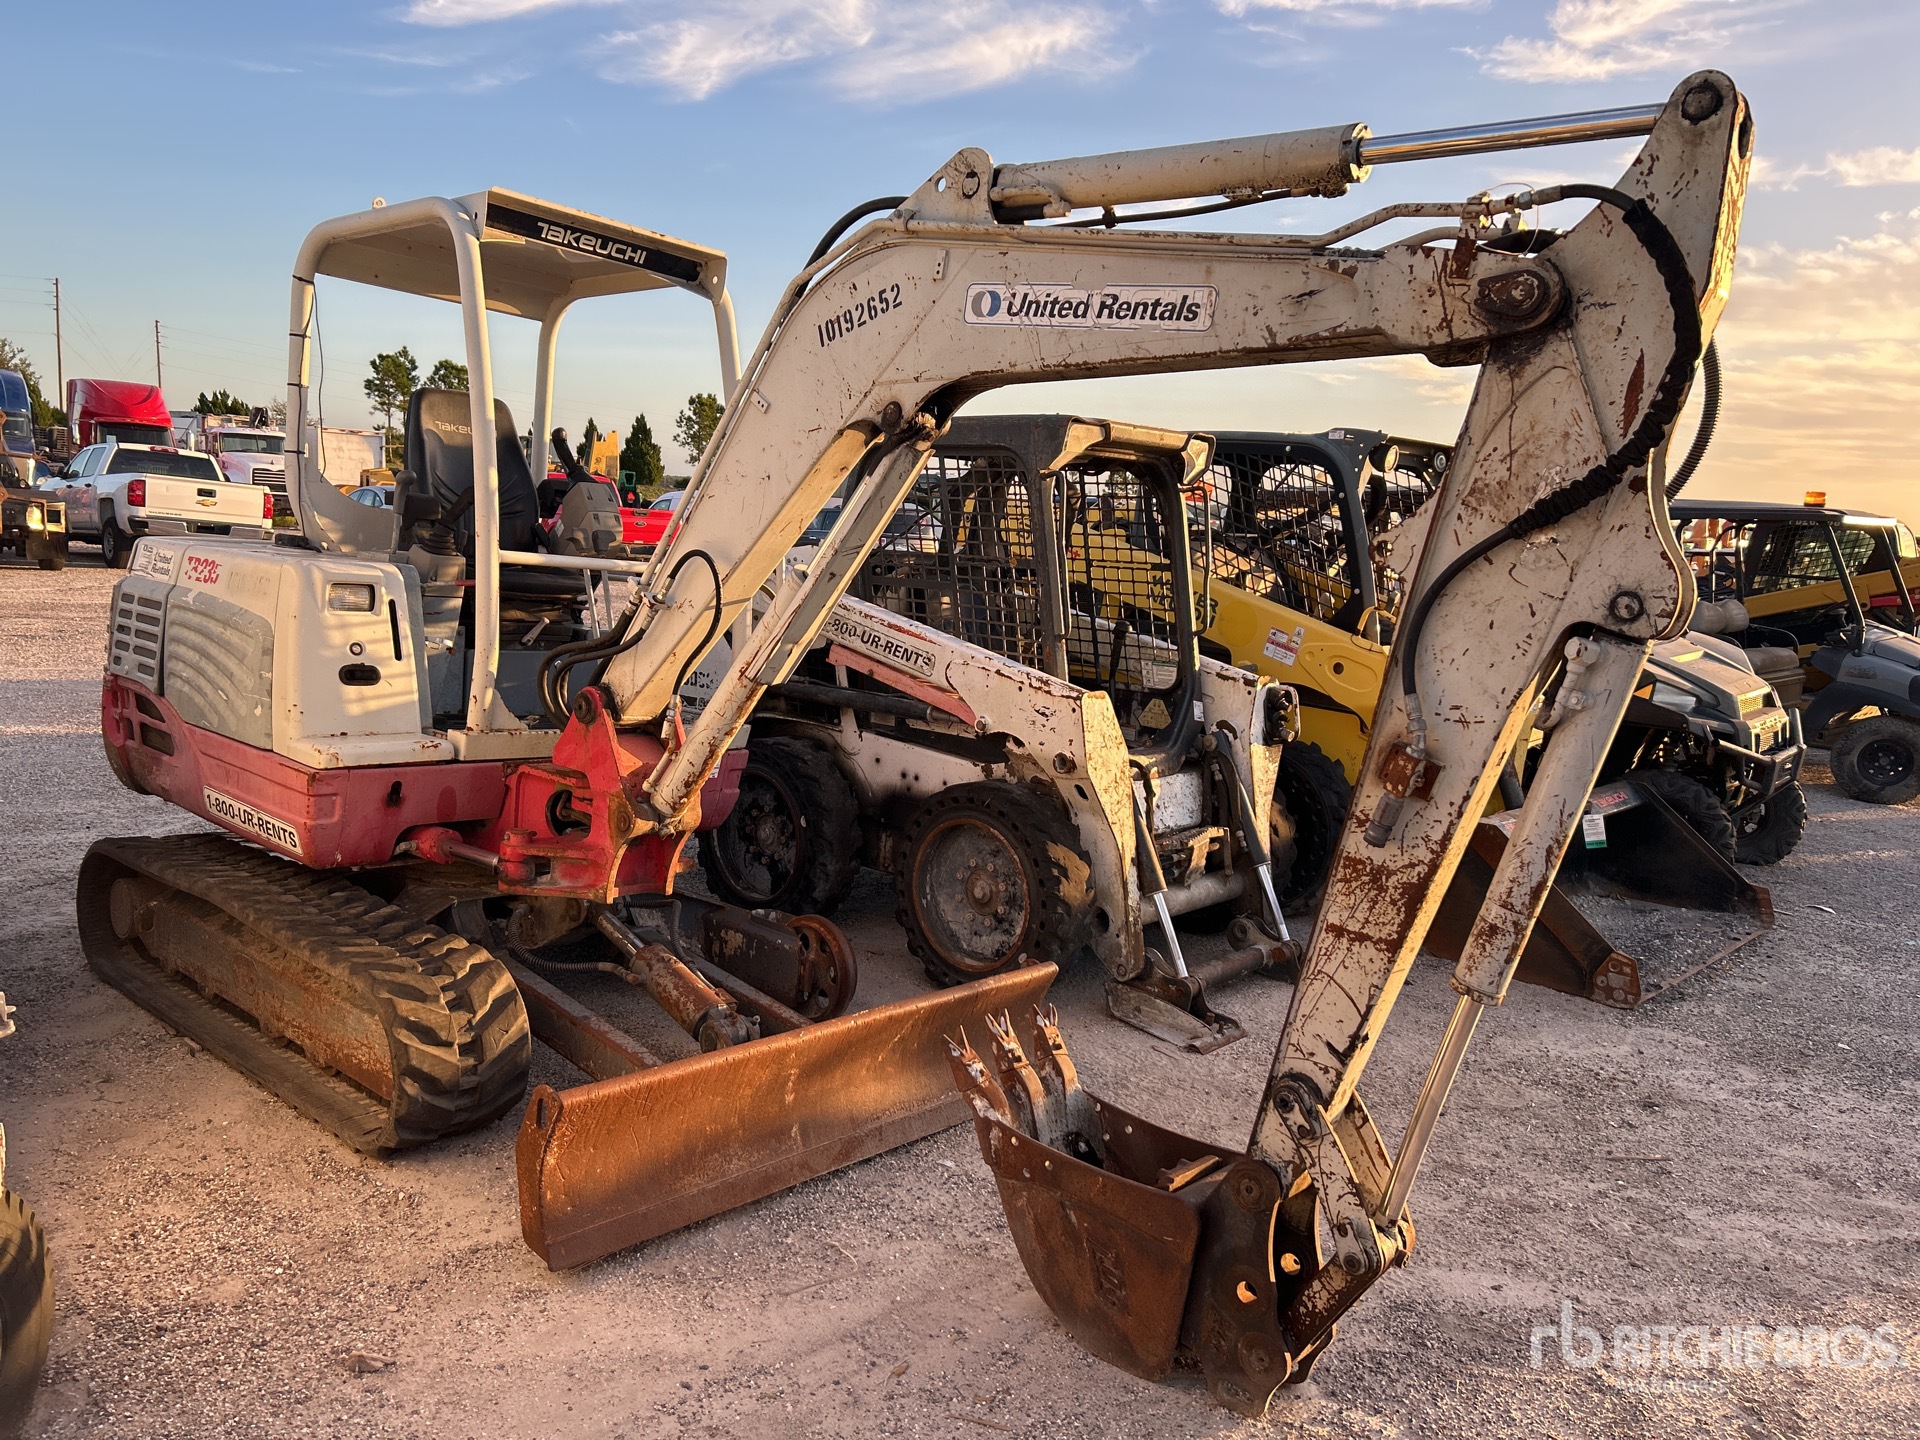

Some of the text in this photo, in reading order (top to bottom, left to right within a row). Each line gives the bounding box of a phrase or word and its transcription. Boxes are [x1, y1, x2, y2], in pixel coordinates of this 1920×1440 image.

[817, 282, 903, 348] 10192652
[1006, 292, 1201, 322] United Rentals
[826, 618, 932, 669] -800-UR-RENTS
[206, 794, 298, 849] 1-800-UR-RENTS
